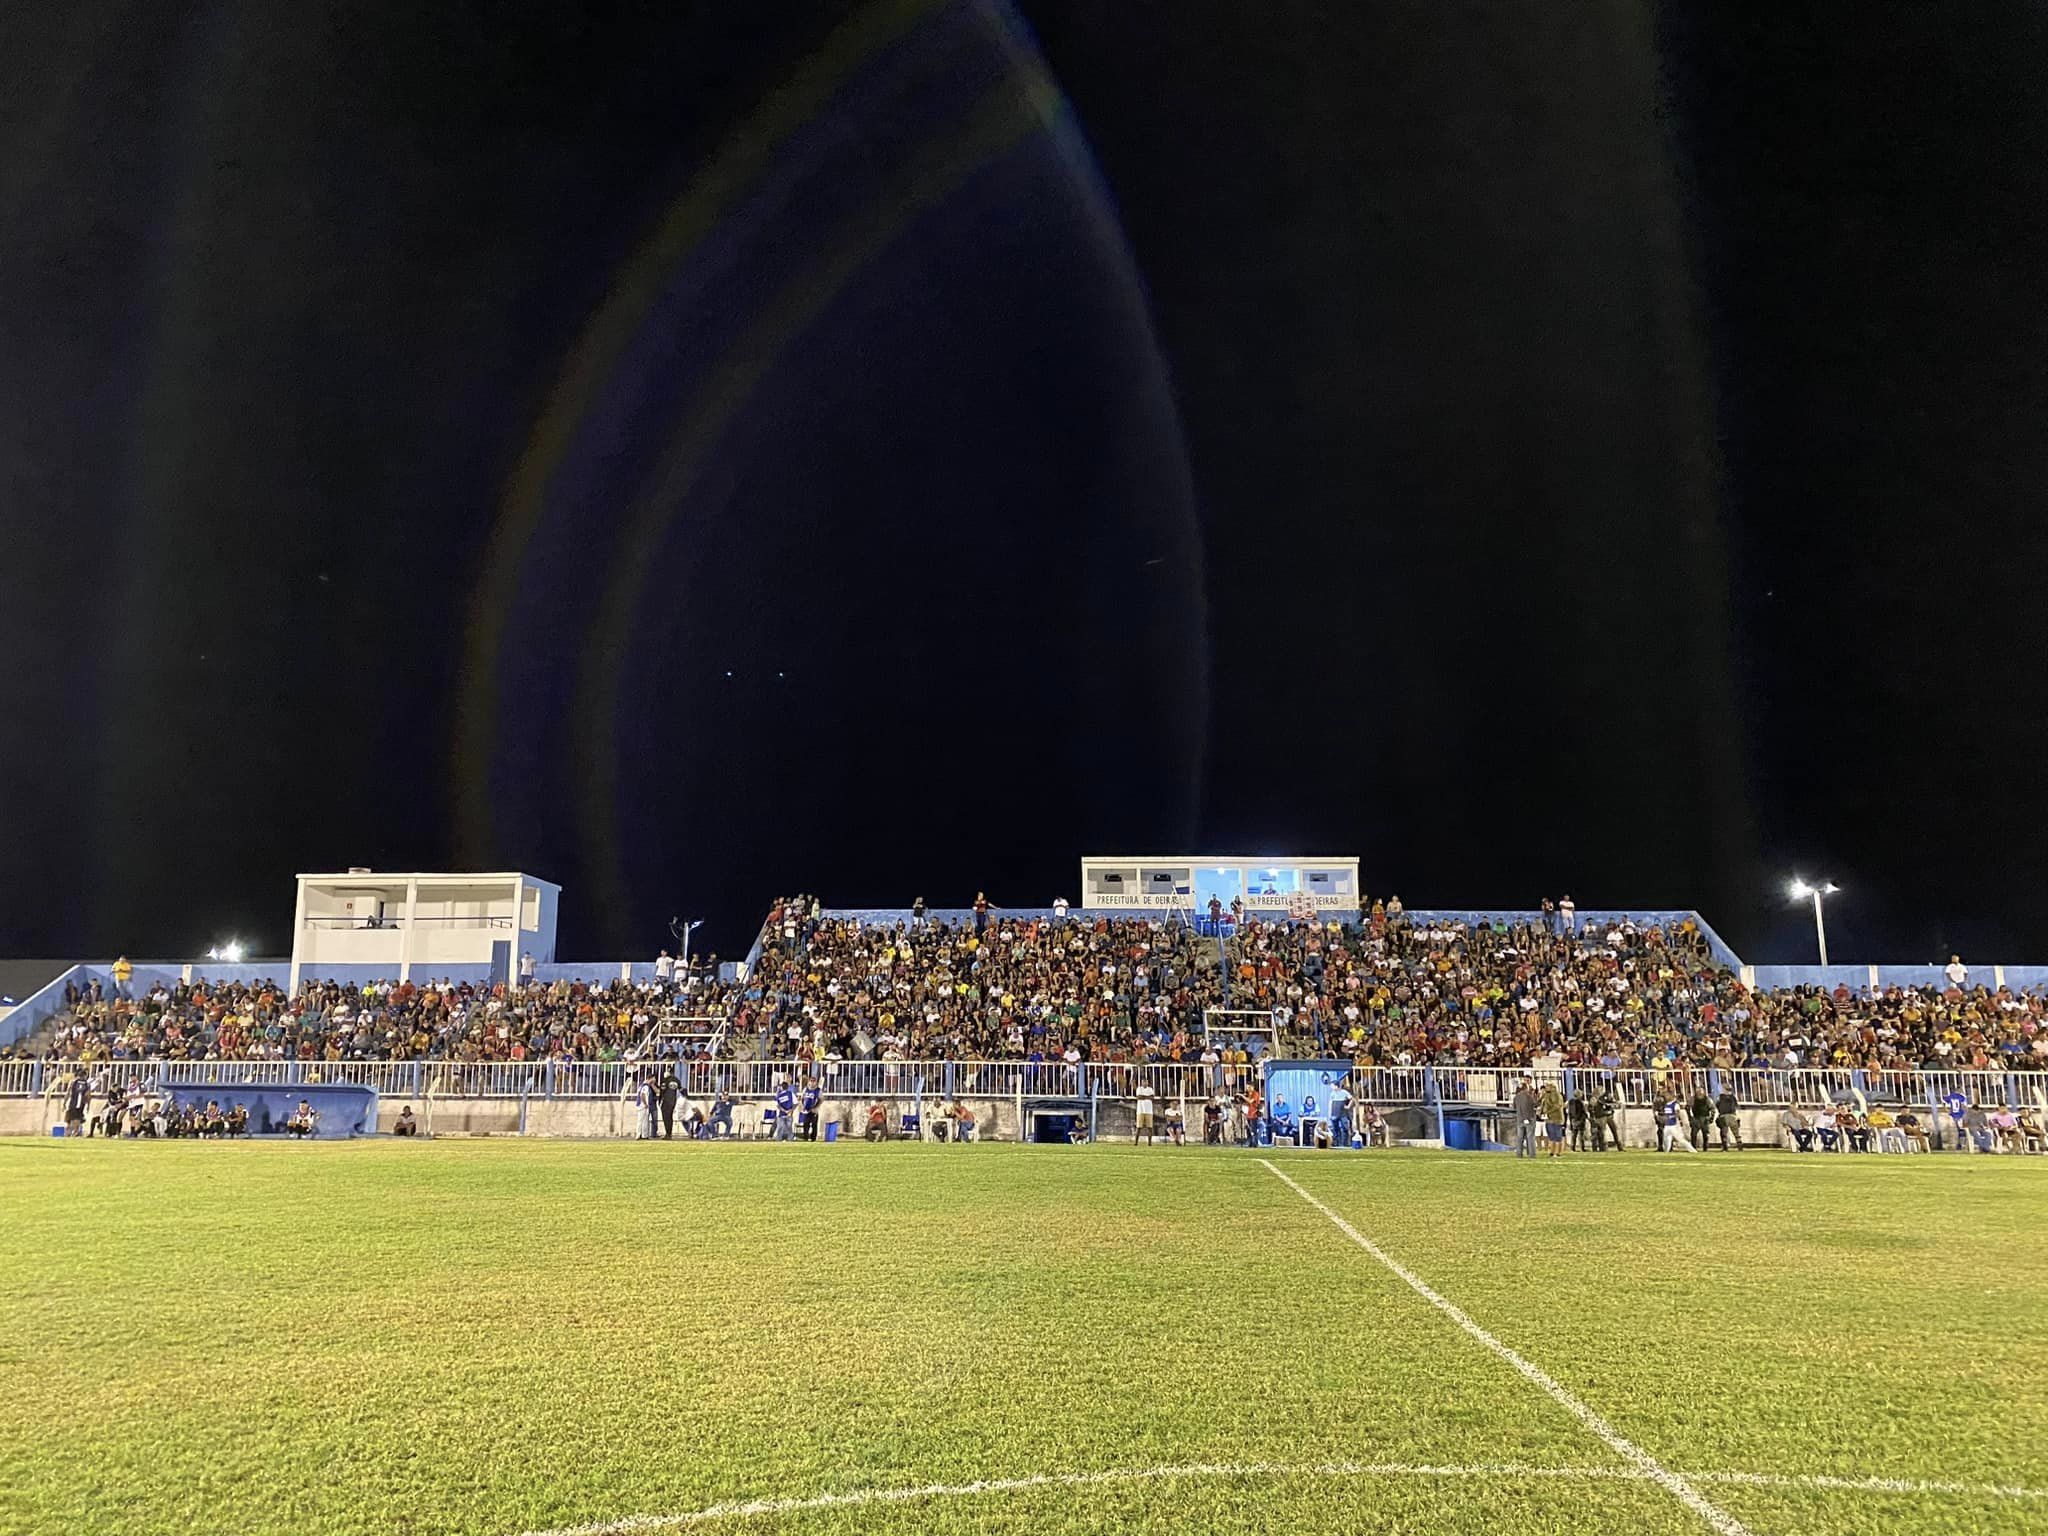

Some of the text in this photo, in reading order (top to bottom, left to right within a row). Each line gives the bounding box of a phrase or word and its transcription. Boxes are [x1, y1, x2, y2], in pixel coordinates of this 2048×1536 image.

[1097, 895, 1179, 904] PREFEITURA DE OEIRAS
[1257, 896, 1289, 905] PREFEITU
[1951, 1098, 1960, 1113] 10
